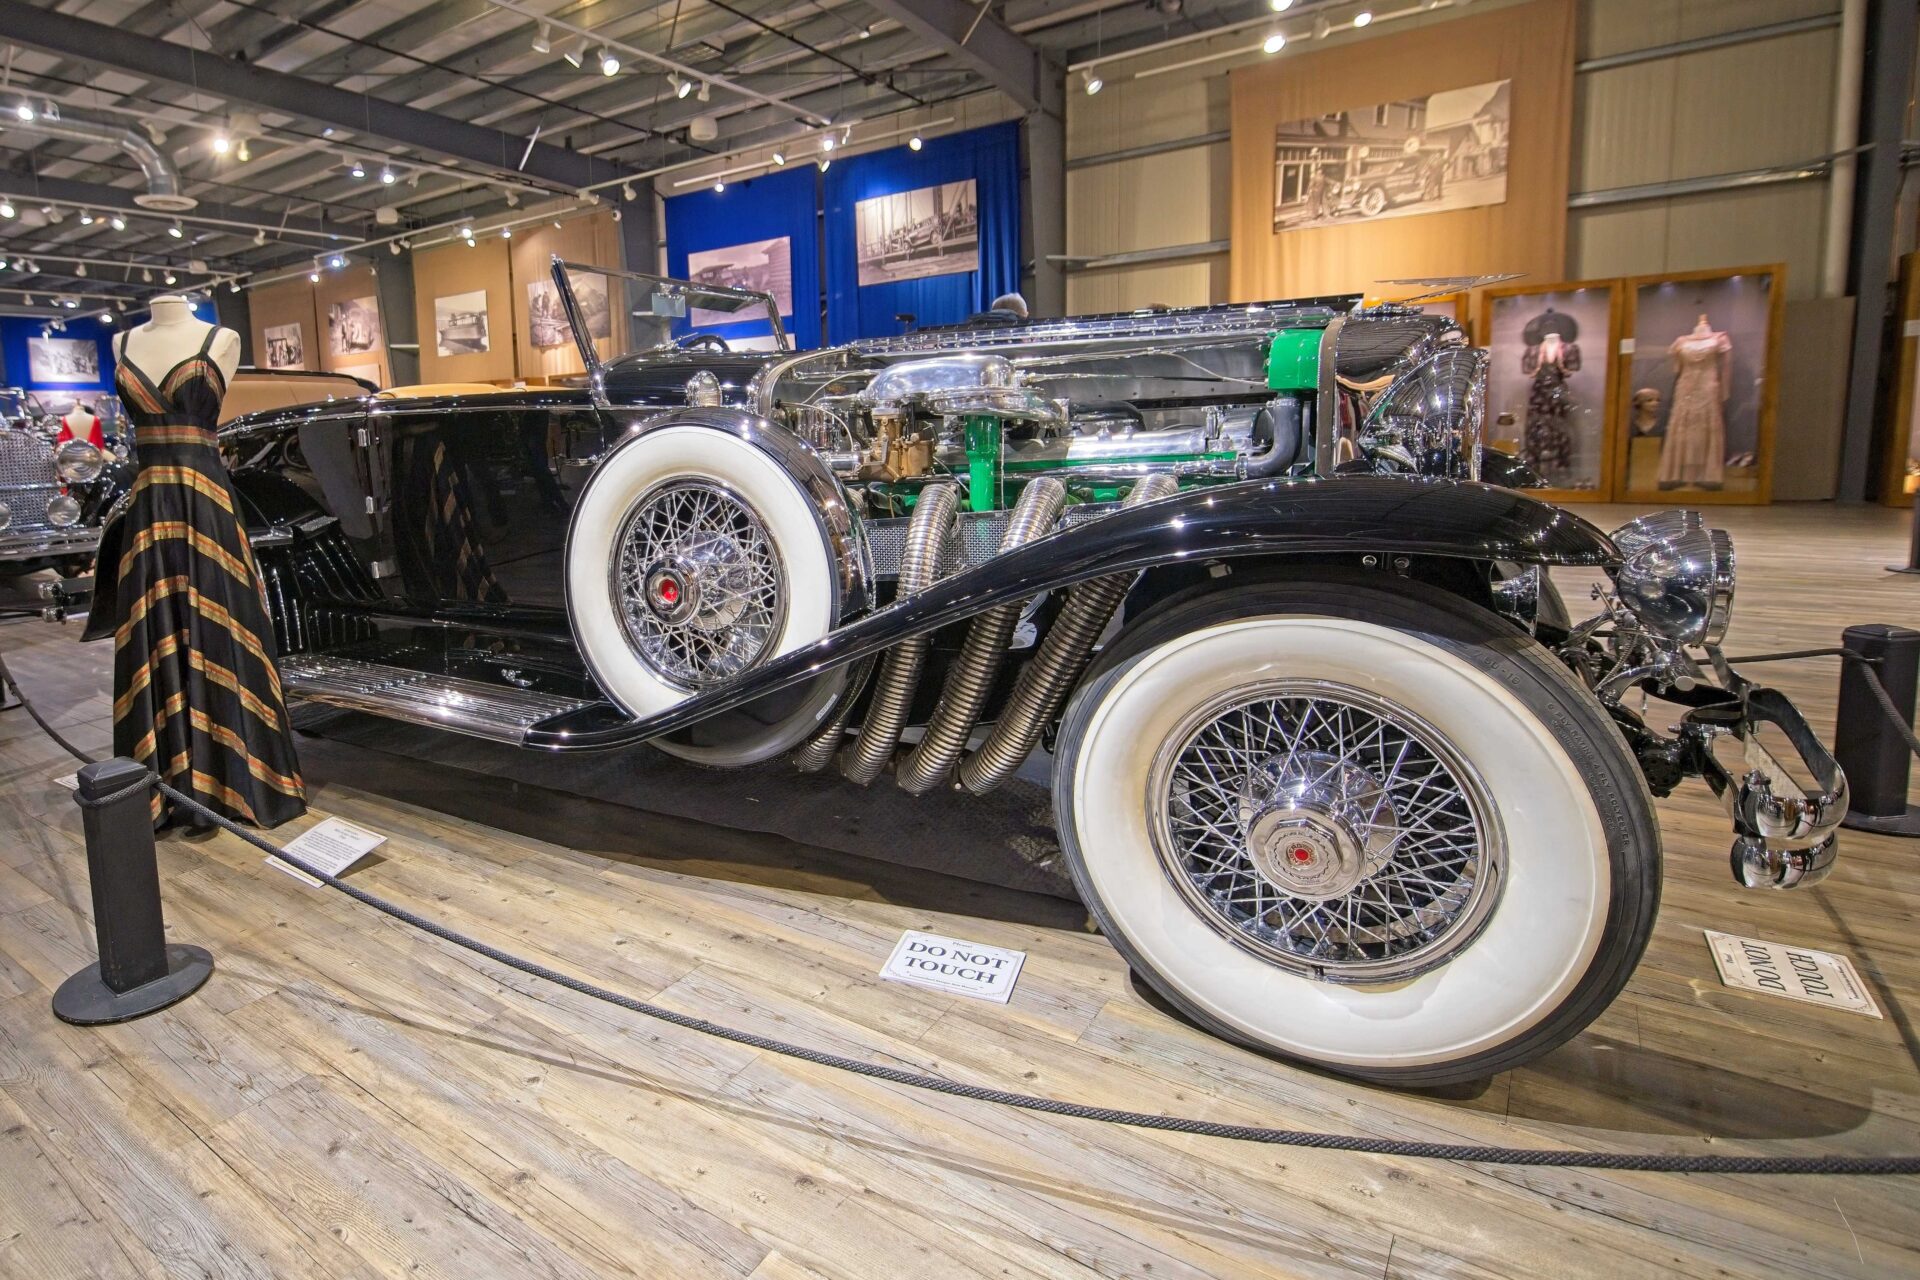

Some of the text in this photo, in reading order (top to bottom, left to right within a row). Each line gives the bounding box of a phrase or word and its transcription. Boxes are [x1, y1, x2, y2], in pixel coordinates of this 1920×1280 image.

[905, 957, 997, 984] TOUCH
[907, 942, 1008, 969] DO NOT
[1740, 940, 1787, 992] DO NOT
[1785, 951, 1834, 998] TOUCH
